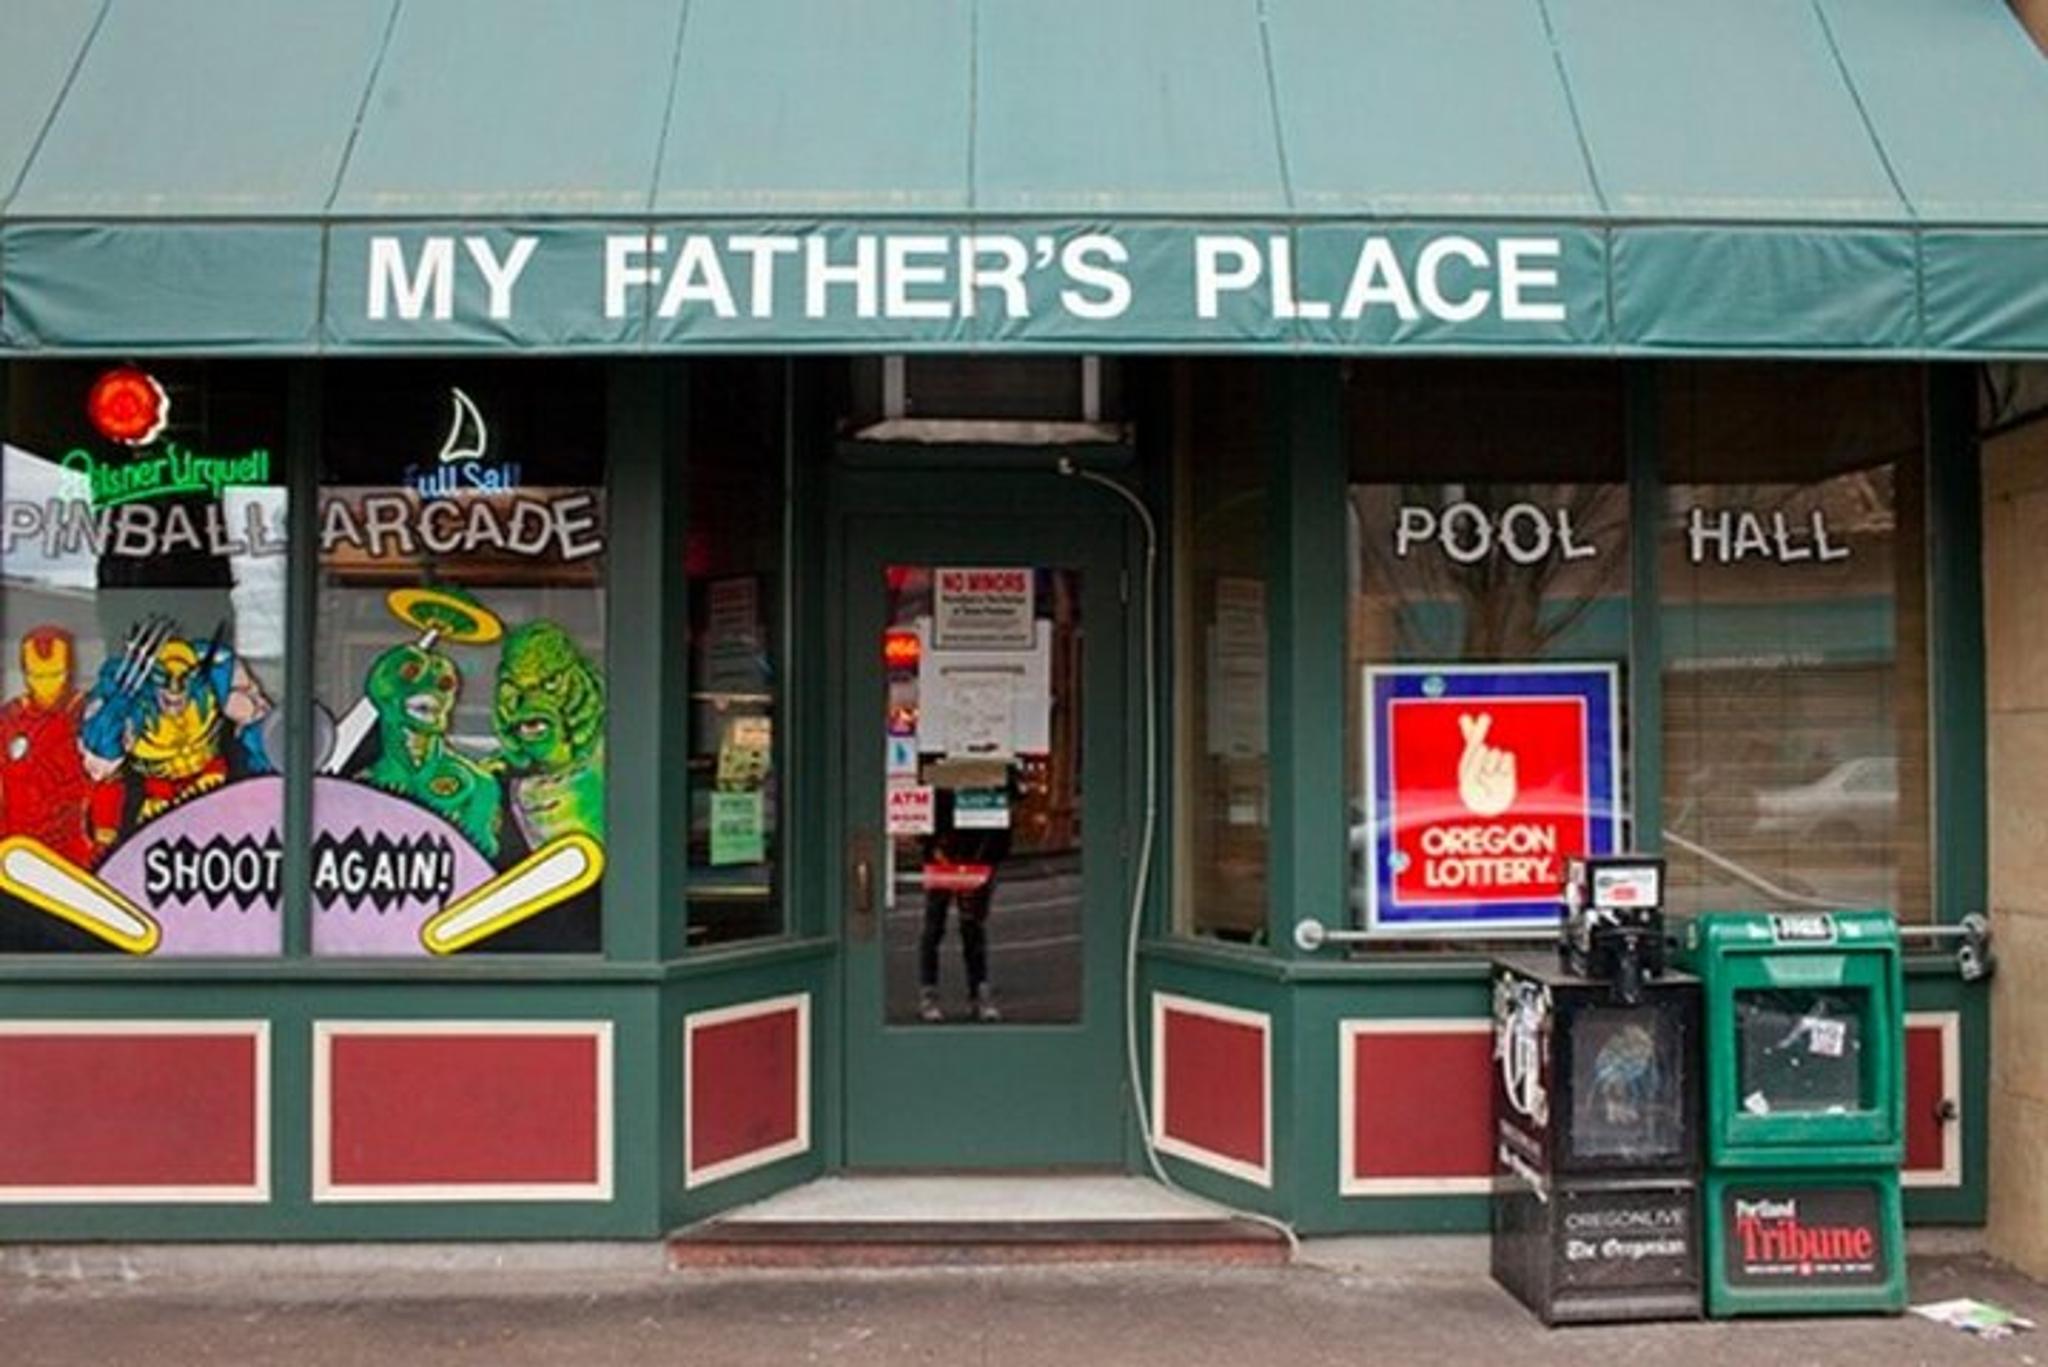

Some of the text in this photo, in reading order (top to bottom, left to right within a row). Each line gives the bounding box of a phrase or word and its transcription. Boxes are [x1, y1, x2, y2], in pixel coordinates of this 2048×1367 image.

[366, 234, 1566, 322] MY FATHER'S PLACE
[167, 443, 270, 499] Urquell
[1, 495, 604, 561] PINBALL ARCADE
[1397, 502, 1851, 563] POOL HALL
[1420, 824, 1557, 856] OREGON
[147, 848, 452, 893] SHOOT AGAIN!
[1740, 1216, 1873, 1262] Tribune
